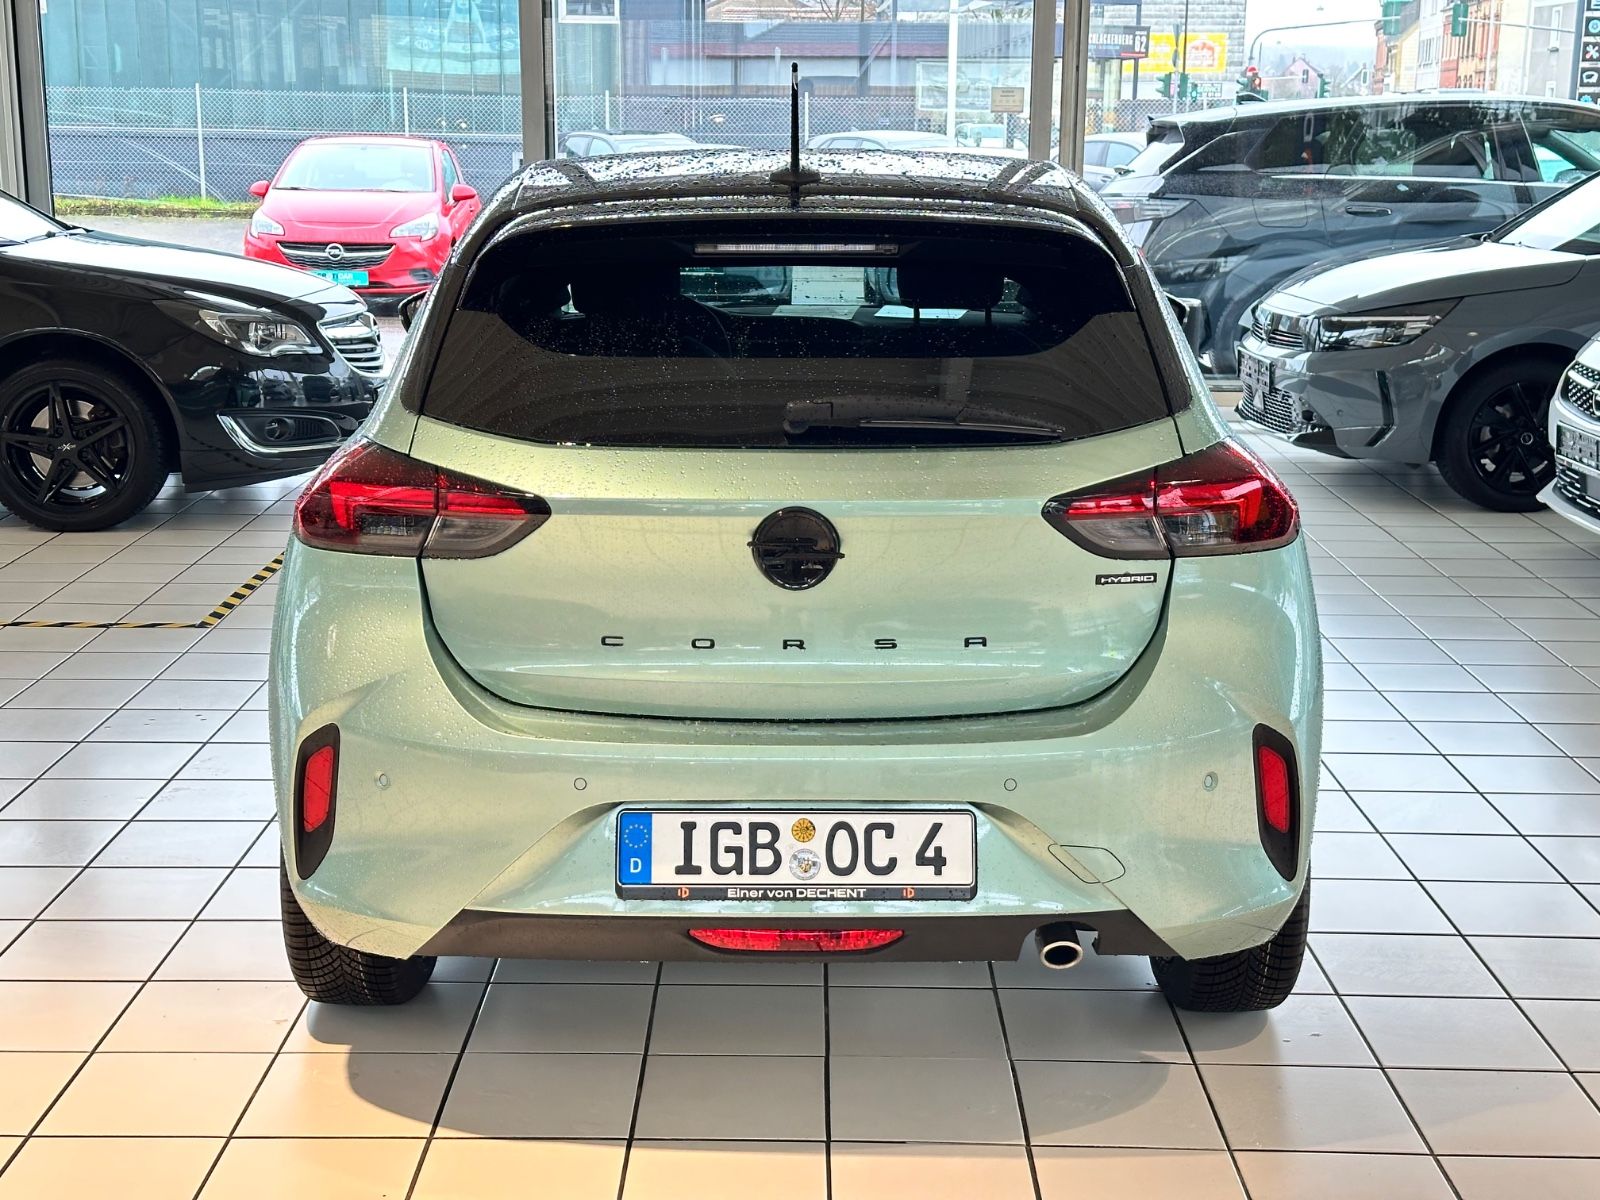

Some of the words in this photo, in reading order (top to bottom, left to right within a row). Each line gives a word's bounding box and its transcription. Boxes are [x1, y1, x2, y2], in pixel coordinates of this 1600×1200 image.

[1088, 33, 1133, 45] CHLACKENBERG
[1134, 36, 1147, 52] 62
[1100, 575, 1154, 584] HYBRID
[601, 636, 987, 650] CORSA
[675, 821, 783, 876] IGB
[825, 821, 898, 877] OC
[915, 823, 947, 876] 4
[629, 857, 642, 873] D
[727, 888, 764, 898] Einer
[767, 889, 793, 898] von
[796, 888, 867, 898] DECHENT
